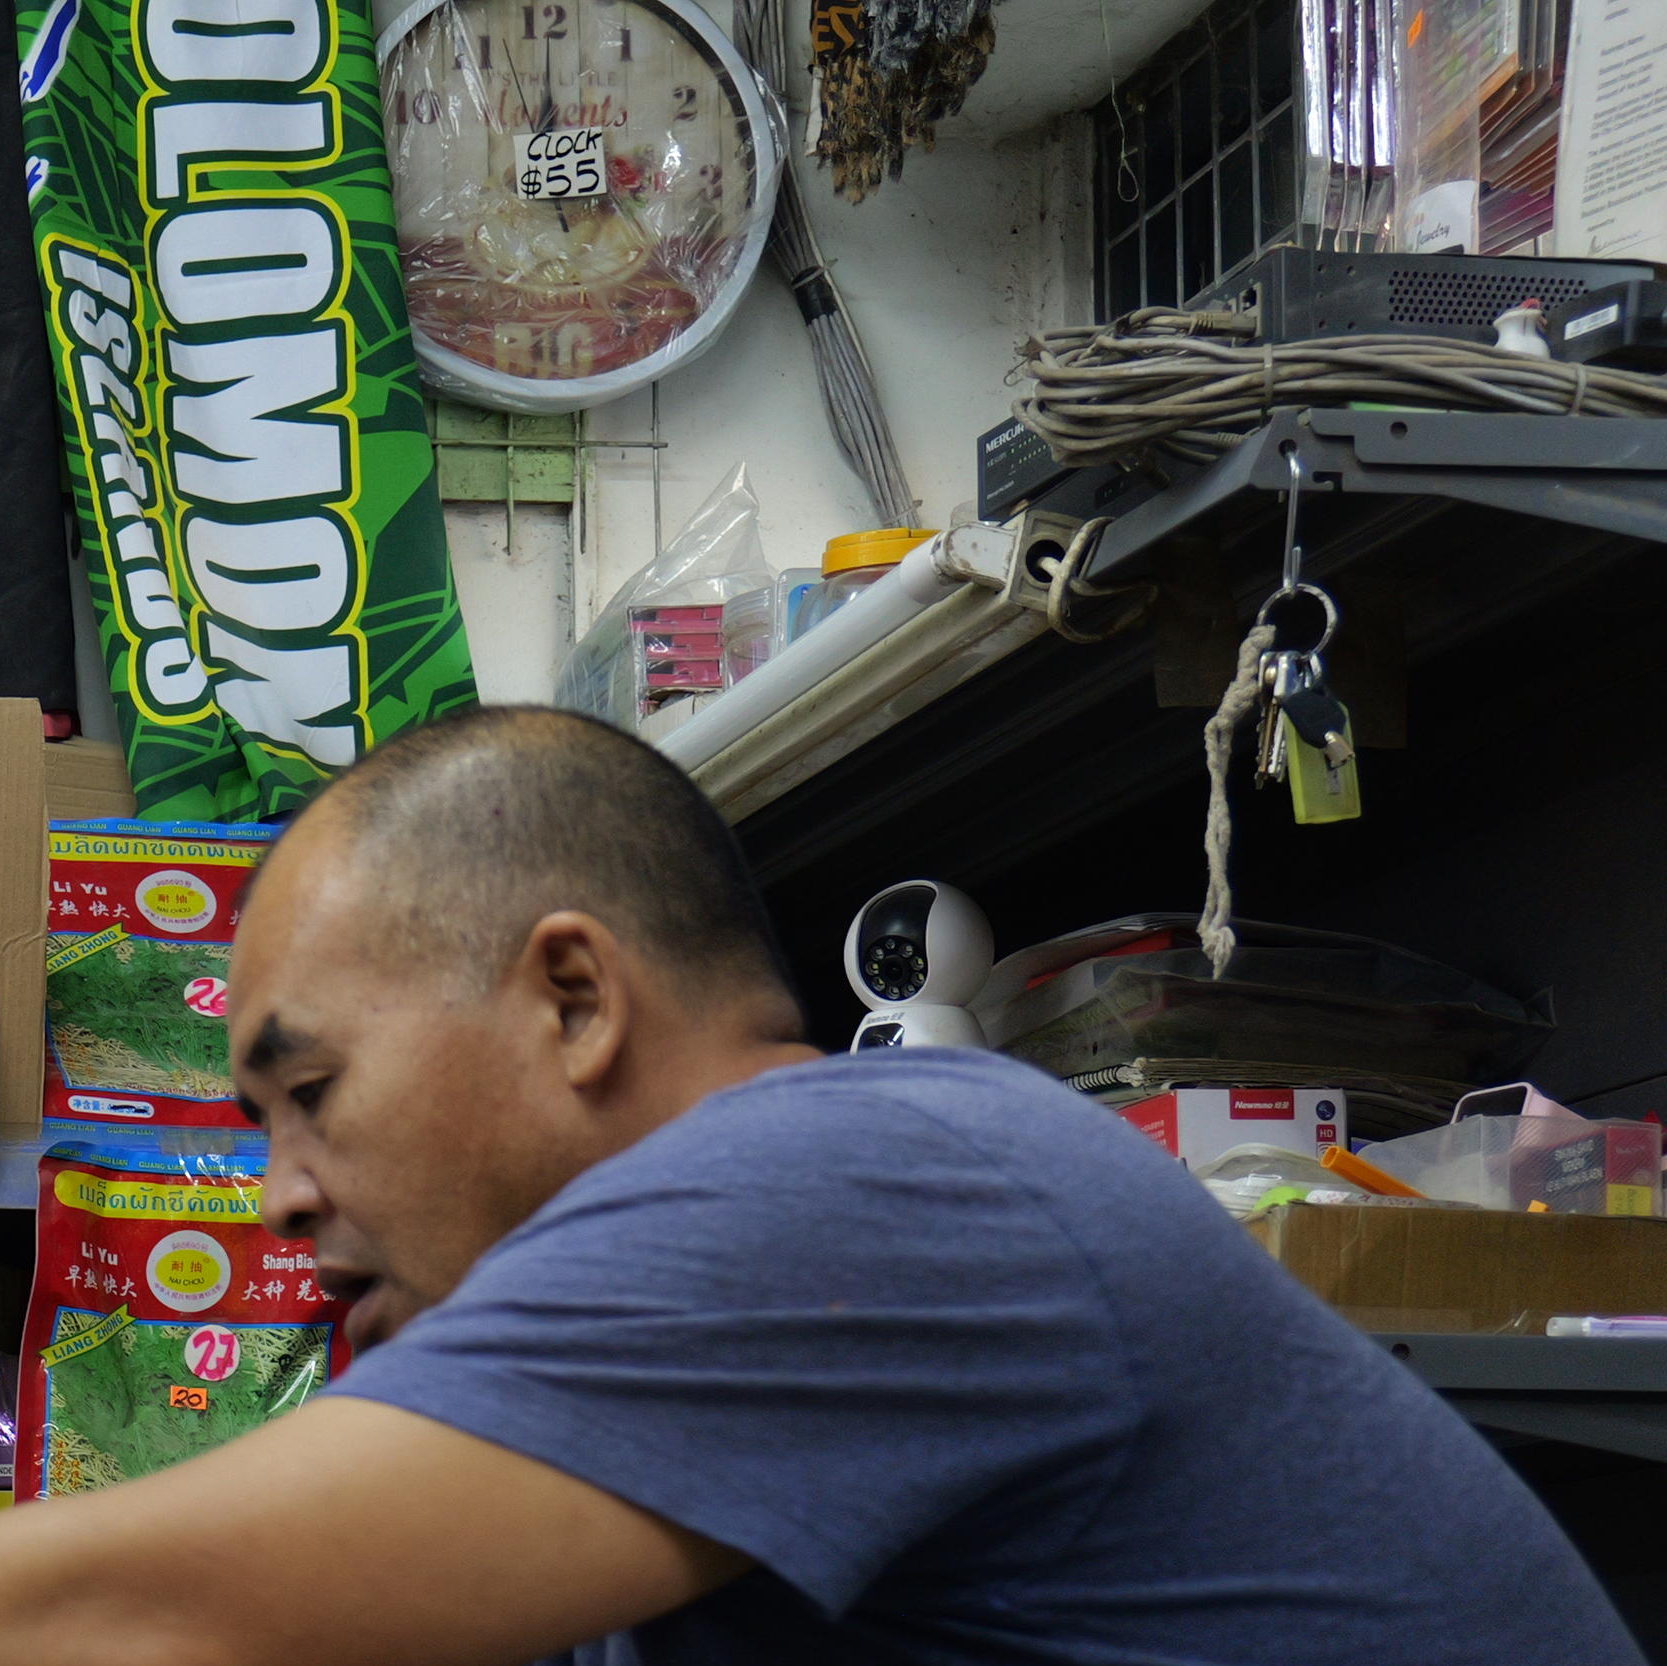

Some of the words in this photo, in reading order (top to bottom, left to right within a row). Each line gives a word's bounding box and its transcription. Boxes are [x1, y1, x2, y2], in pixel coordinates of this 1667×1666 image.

[522, 5, 567, 39] 12
[672, 86, 697, 122] 2
[527, 130, 602, 161] CLOCK
[521, 158, 600, 199] $55
[79, 881, 108, 895] Yu
[52, 1335, 94, 1361] LIANG
[192, 1329, 236, 1380] 27
